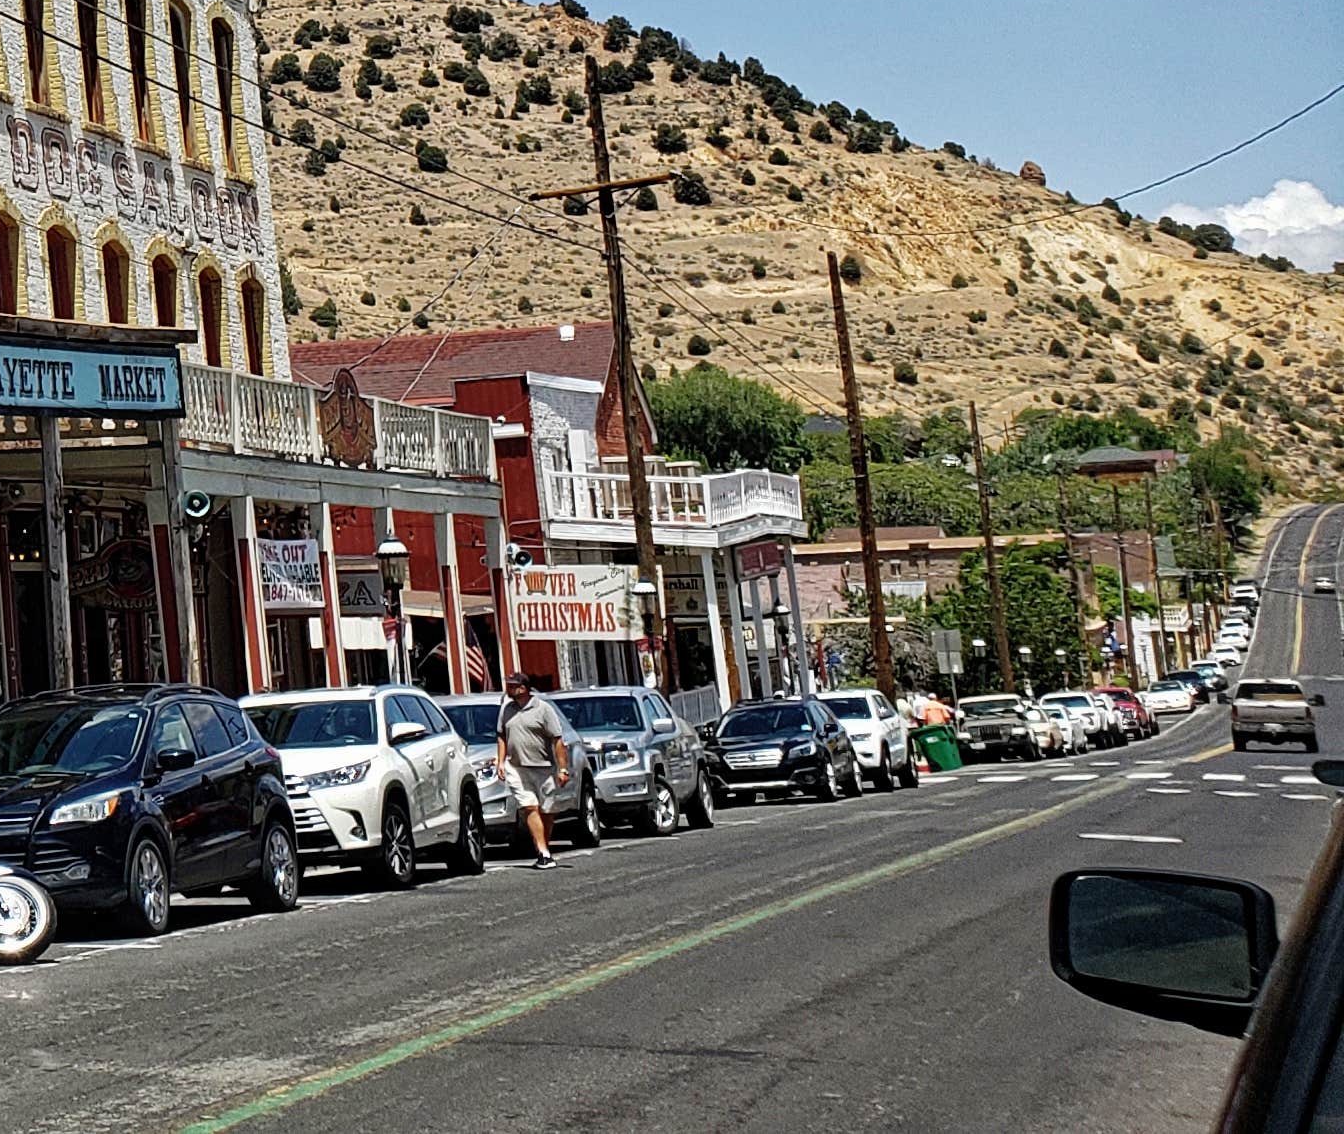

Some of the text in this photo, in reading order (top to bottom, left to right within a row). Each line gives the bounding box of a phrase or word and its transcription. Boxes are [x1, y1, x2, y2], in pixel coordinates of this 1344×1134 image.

[7, 115, 104, 211] DOG
[111, 153, 265, 256] SALOON
[98, 364, 167, 402] MARKET
[517, 602, 616, 632] CHRISTMAS
